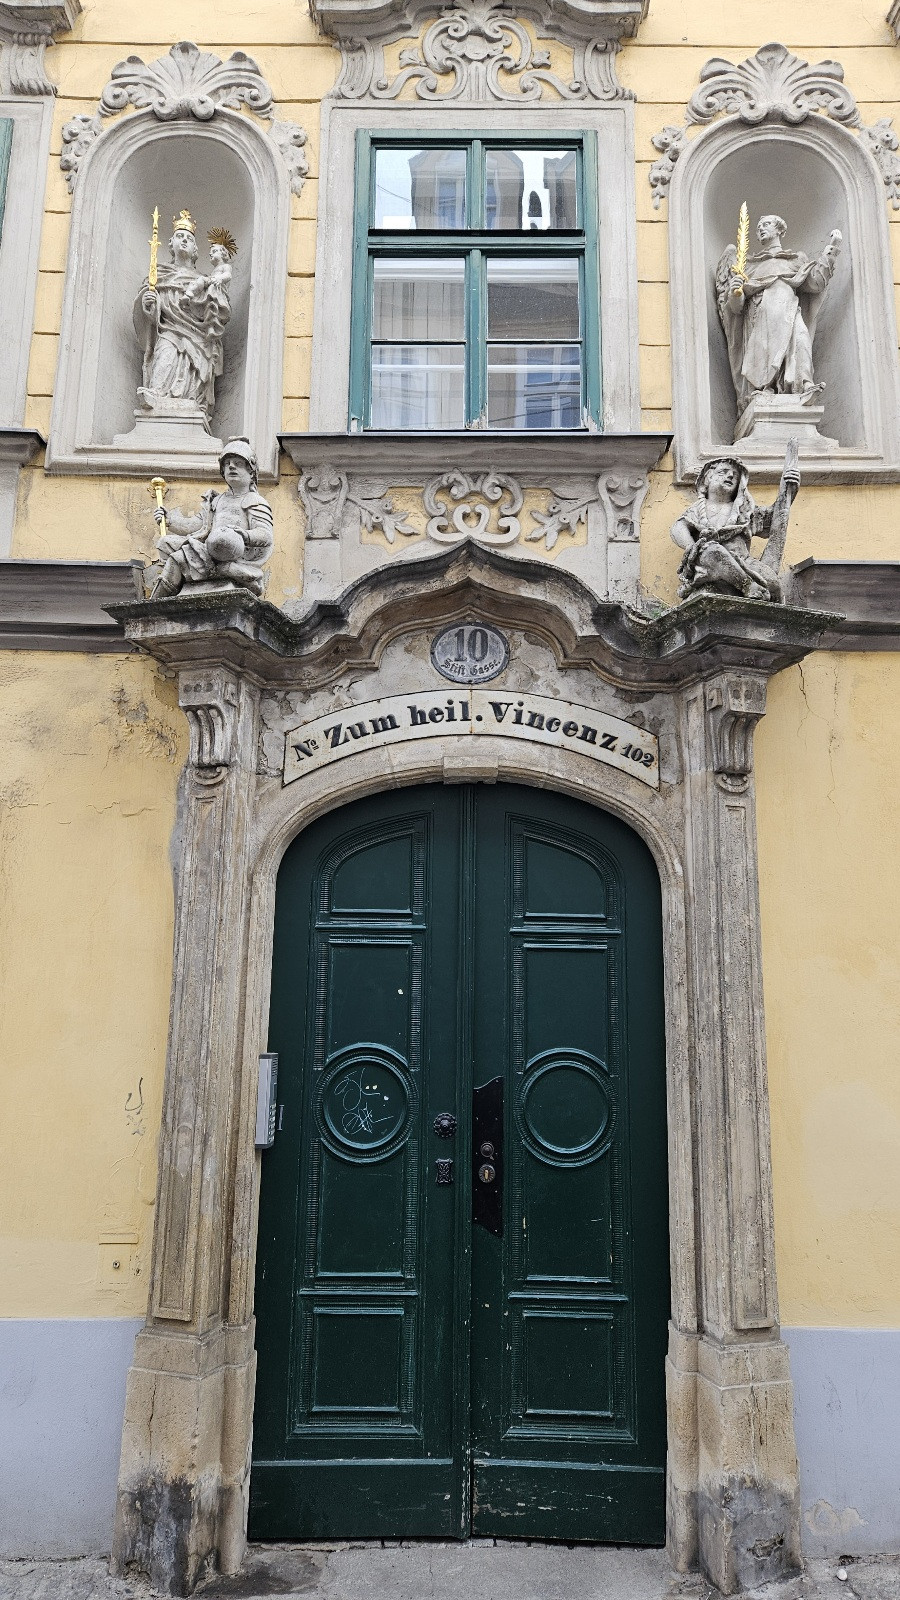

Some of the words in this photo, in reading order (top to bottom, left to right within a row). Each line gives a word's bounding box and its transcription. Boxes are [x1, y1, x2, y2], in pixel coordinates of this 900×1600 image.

[454, 628, 488, 662] 10
[324, 714, 401, 748] Zum
[407, 699, 483, 726] heil.
[488, 701, 618, 752] Vincenz
[620, 743, 655, 768] 102
